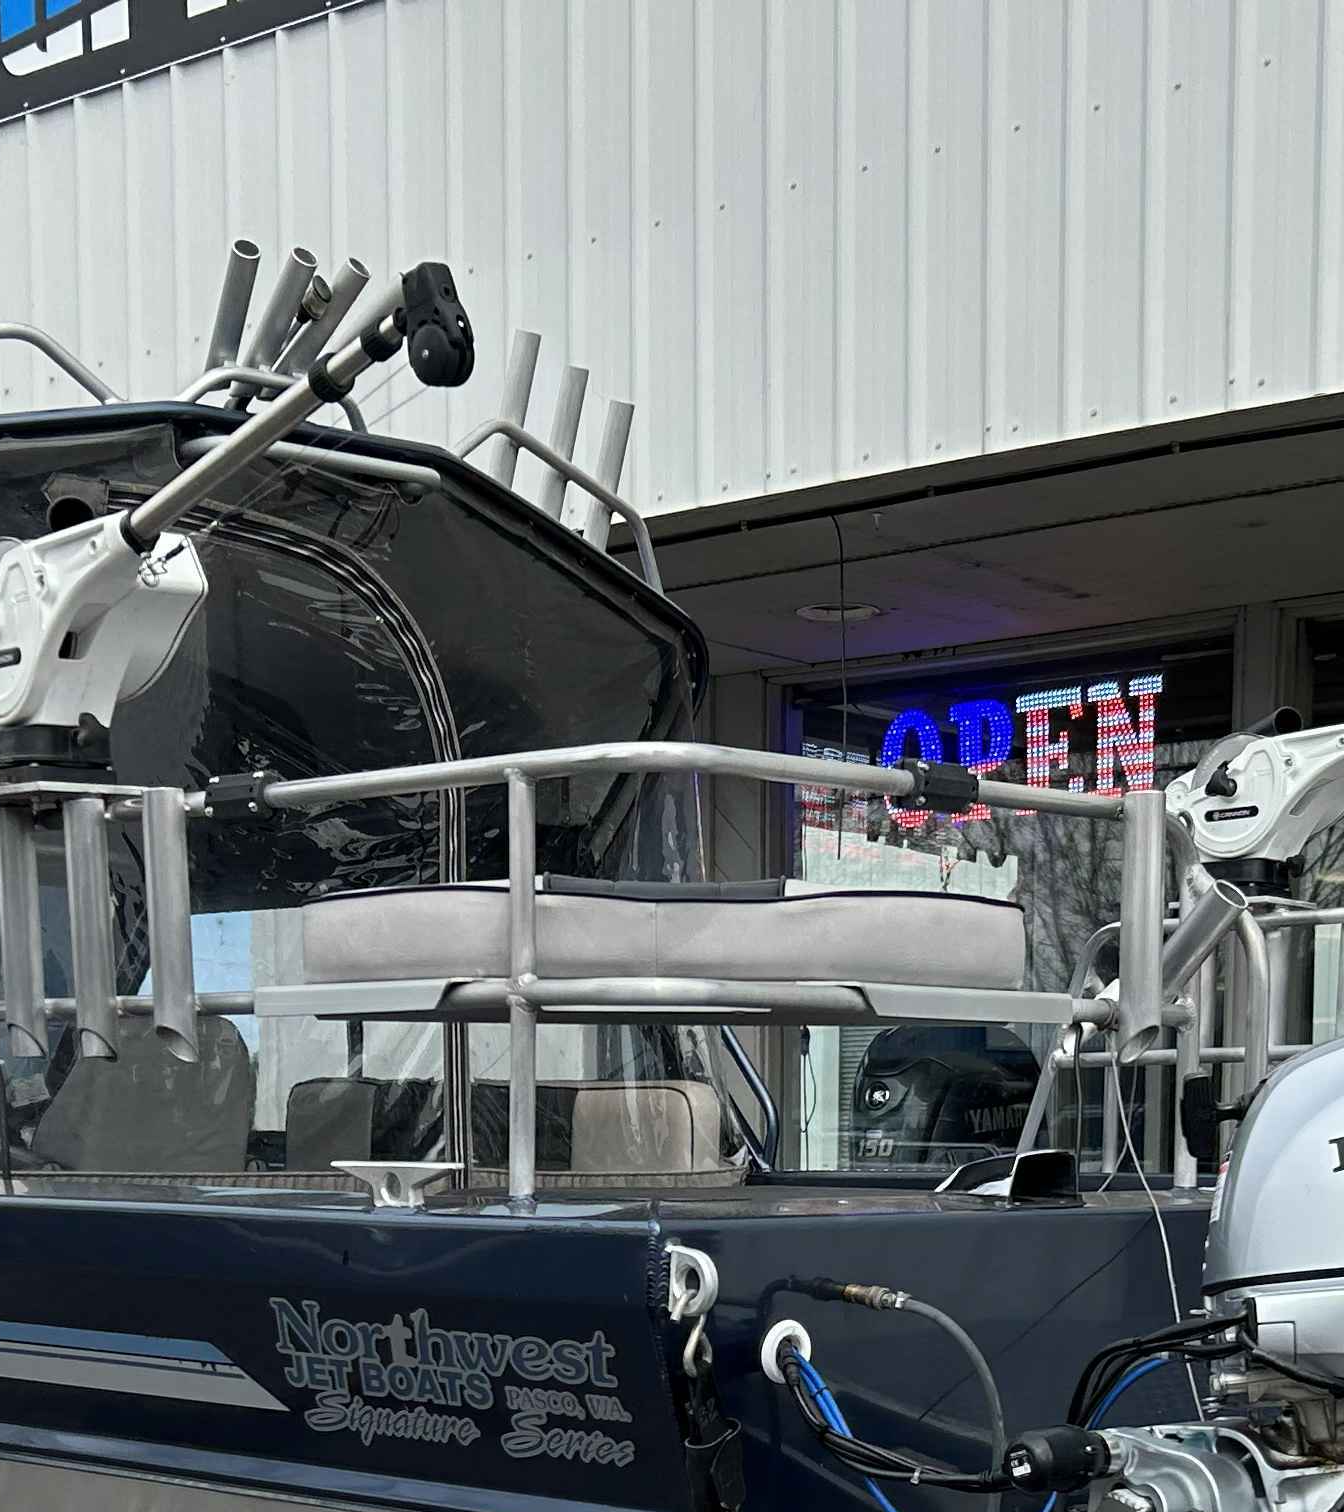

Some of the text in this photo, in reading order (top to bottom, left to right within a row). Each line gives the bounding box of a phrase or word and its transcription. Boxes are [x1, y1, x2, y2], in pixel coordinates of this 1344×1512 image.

[881, 674, 1163, 828] OPEN
[969, 1102, 1031, 1134] YAMAH
[857, 1138, 895, 1159] 150
[268, 1297, 618, 1388] Northwest
[283, 1352, 495, 1410] JET BOATS
[504, 1386, 586, 1420] PASCO,
[304, 1391, 635, 1467] Signature Series
